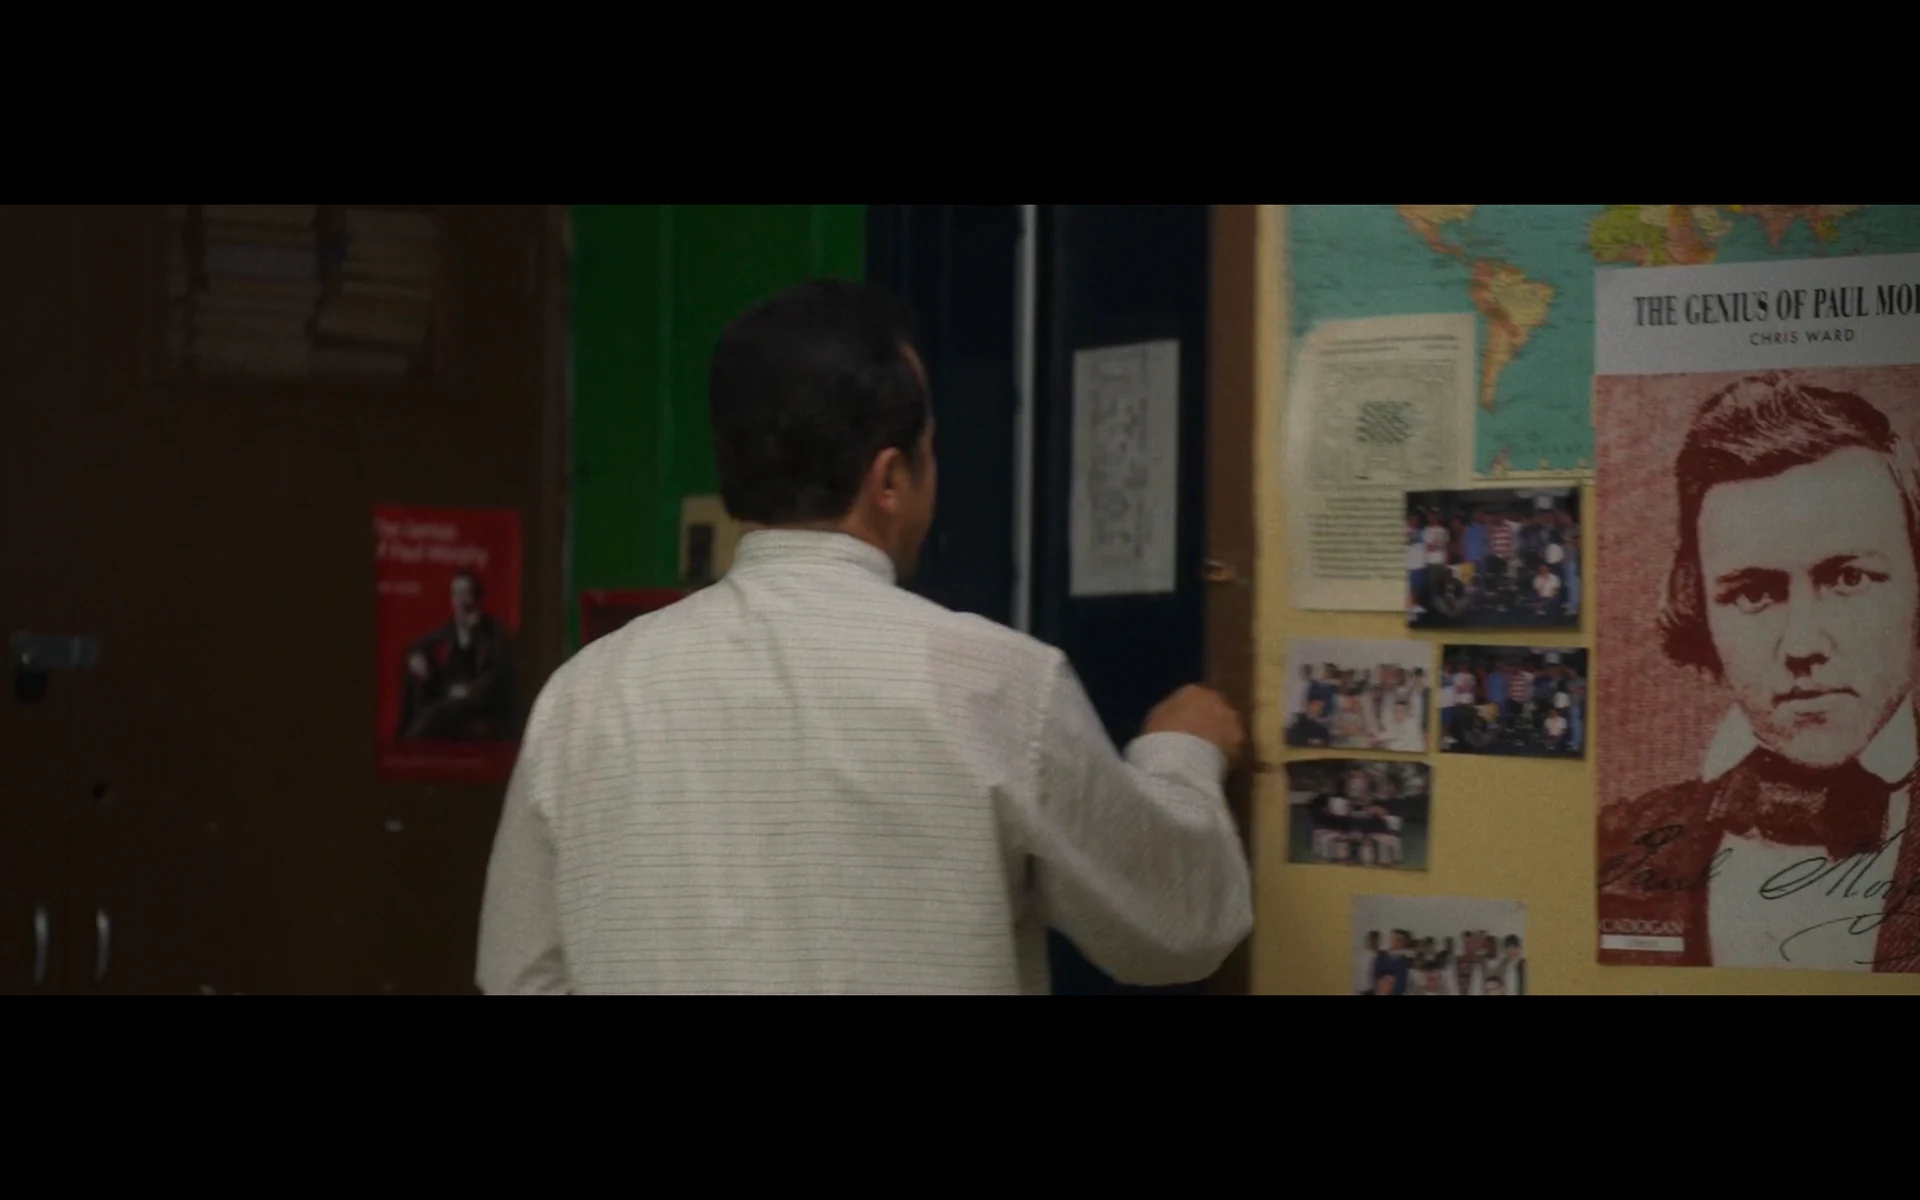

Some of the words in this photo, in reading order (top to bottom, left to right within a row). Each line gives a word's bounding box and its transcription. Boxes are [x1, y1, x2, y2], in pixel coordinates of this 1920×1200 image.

[1634, 295, 1678, 326] THE
[1685, 291, 1769, 325] GENIUS
[1776, 289, 1807, 320] OF
[1814, 286, 1868, 318] PAUL
[1750, 330, 1798, 346] CHRIS
[1805, 328, 1855, 343] WARD
